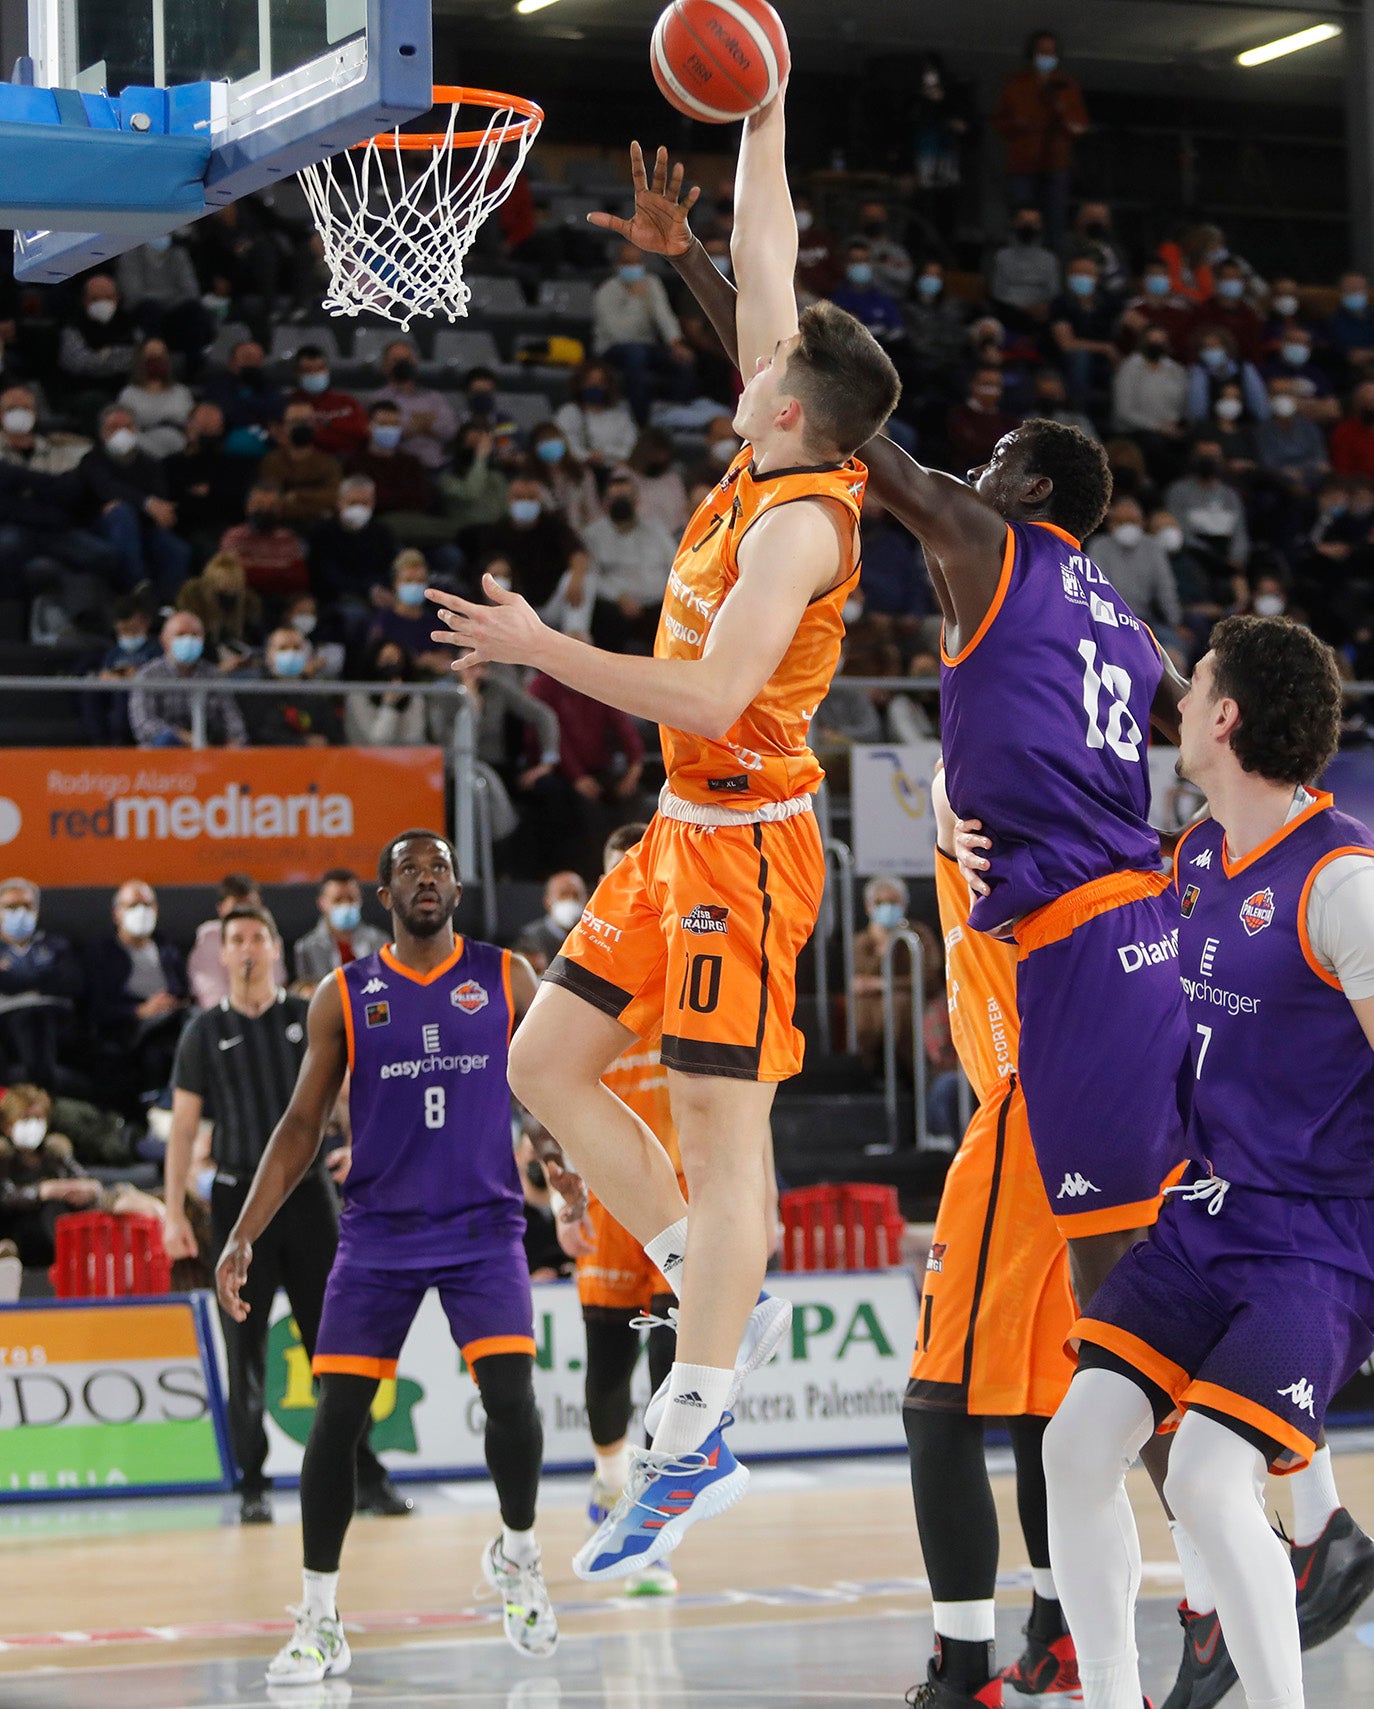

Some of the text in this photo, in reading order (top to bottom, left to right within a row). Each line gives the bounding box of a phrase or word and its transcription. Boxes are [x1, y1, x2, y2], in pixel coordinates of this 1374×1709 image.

[705, 18, 751, 70] molten
[726, 780, 737, 788] XL
[681, 917, 728, 933] IRAURGI
[679, 951, 722, 1014] 10
[380, 1054, 490, 1080] easycharger
[1196, 1023, 1213, 1081] 7
[424, 1086, 446, 1129] 8
[0, 1365, 210, 1430] DOS
[674, 1397, 707, 1409] adidas
